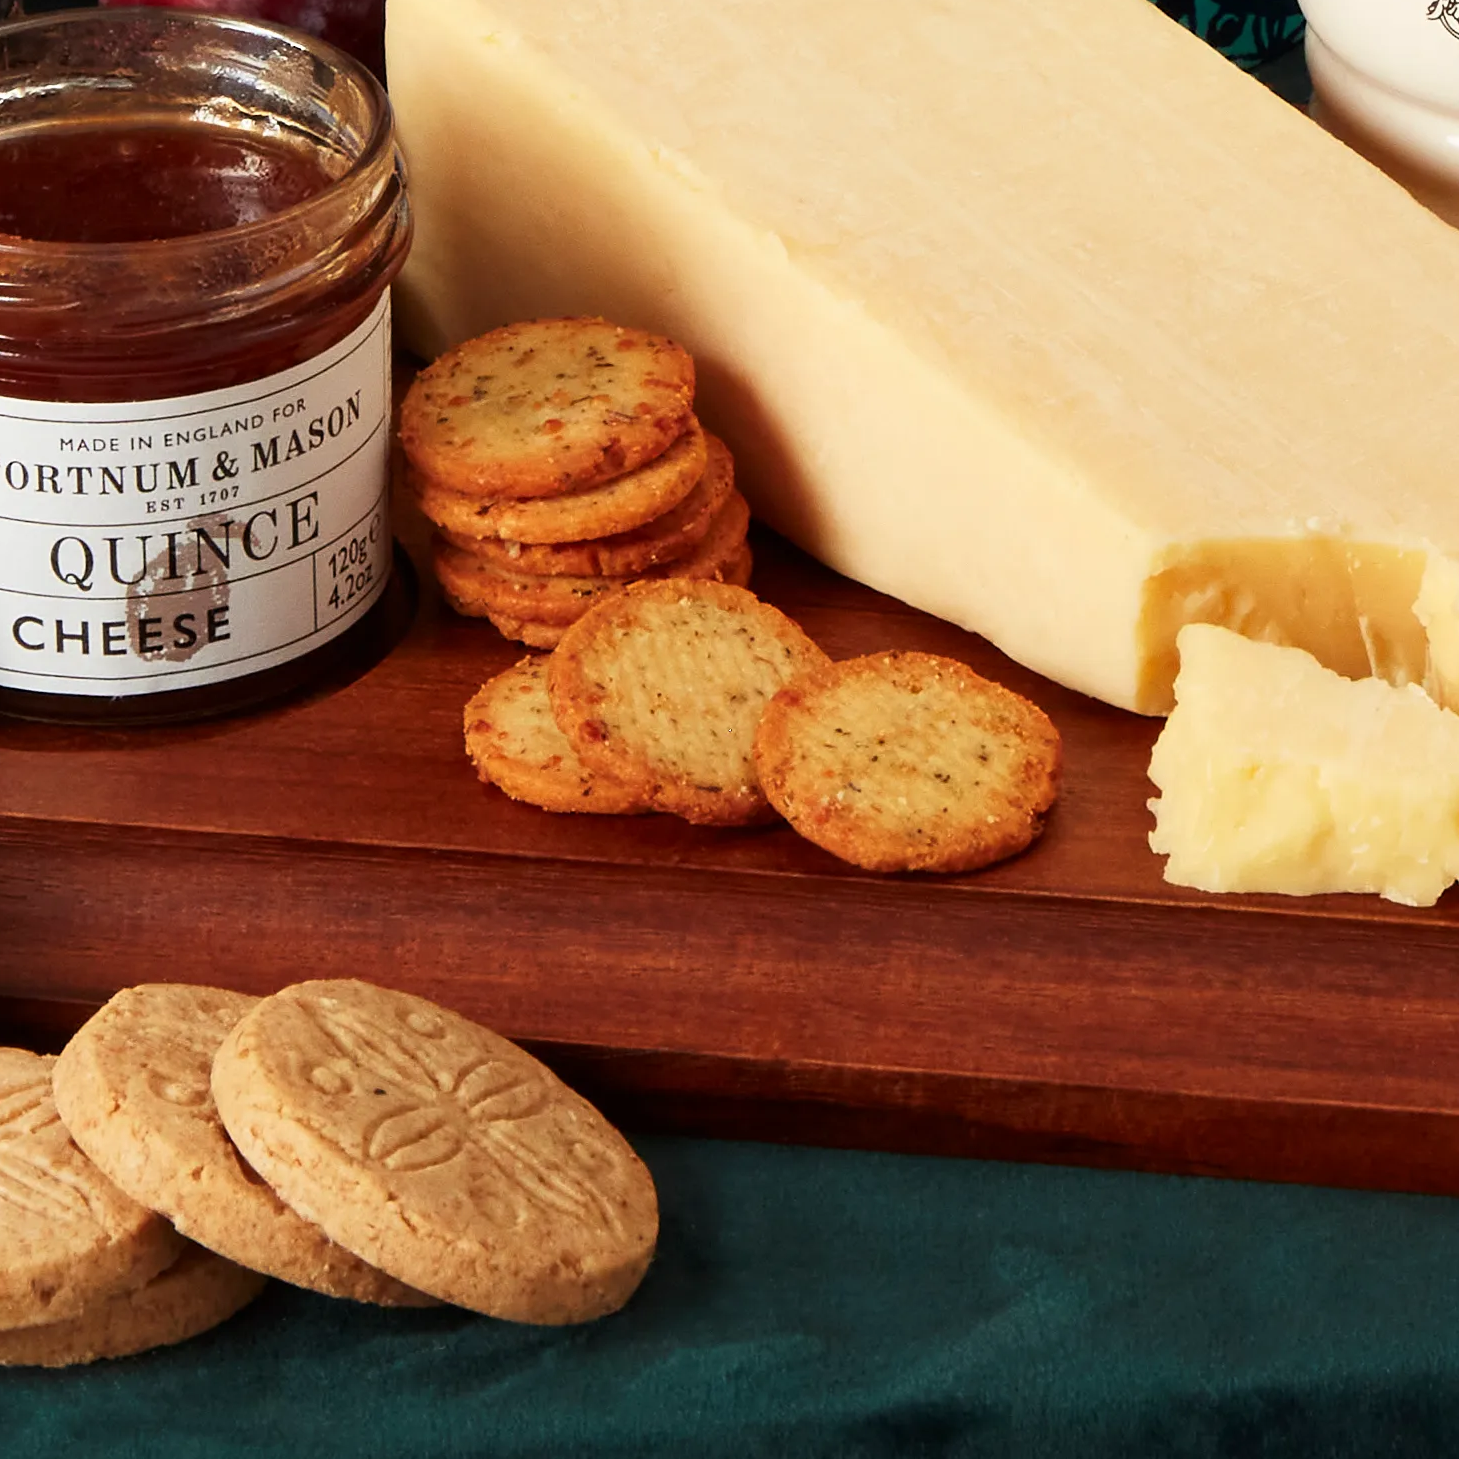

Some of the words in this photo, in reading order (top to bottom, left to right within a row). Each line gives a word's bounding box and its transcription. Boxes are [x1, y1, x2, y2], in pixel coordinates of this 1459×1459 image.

[60, 437, 119, 454] MADE
[130, 434, 152, 449] IN
[164, 413, 264, 449] ENGLAND
[272, 397, 307, 422] FOR
[212, 451, 240, 481] &
[251, 389, 363, 473] MASON
[146, 496, 186, 515] EST
[199, 485, 241, 507] 1707
[49, 490, 320, 593] QUINCE
[12, 605, 232, 657] CHEESE
